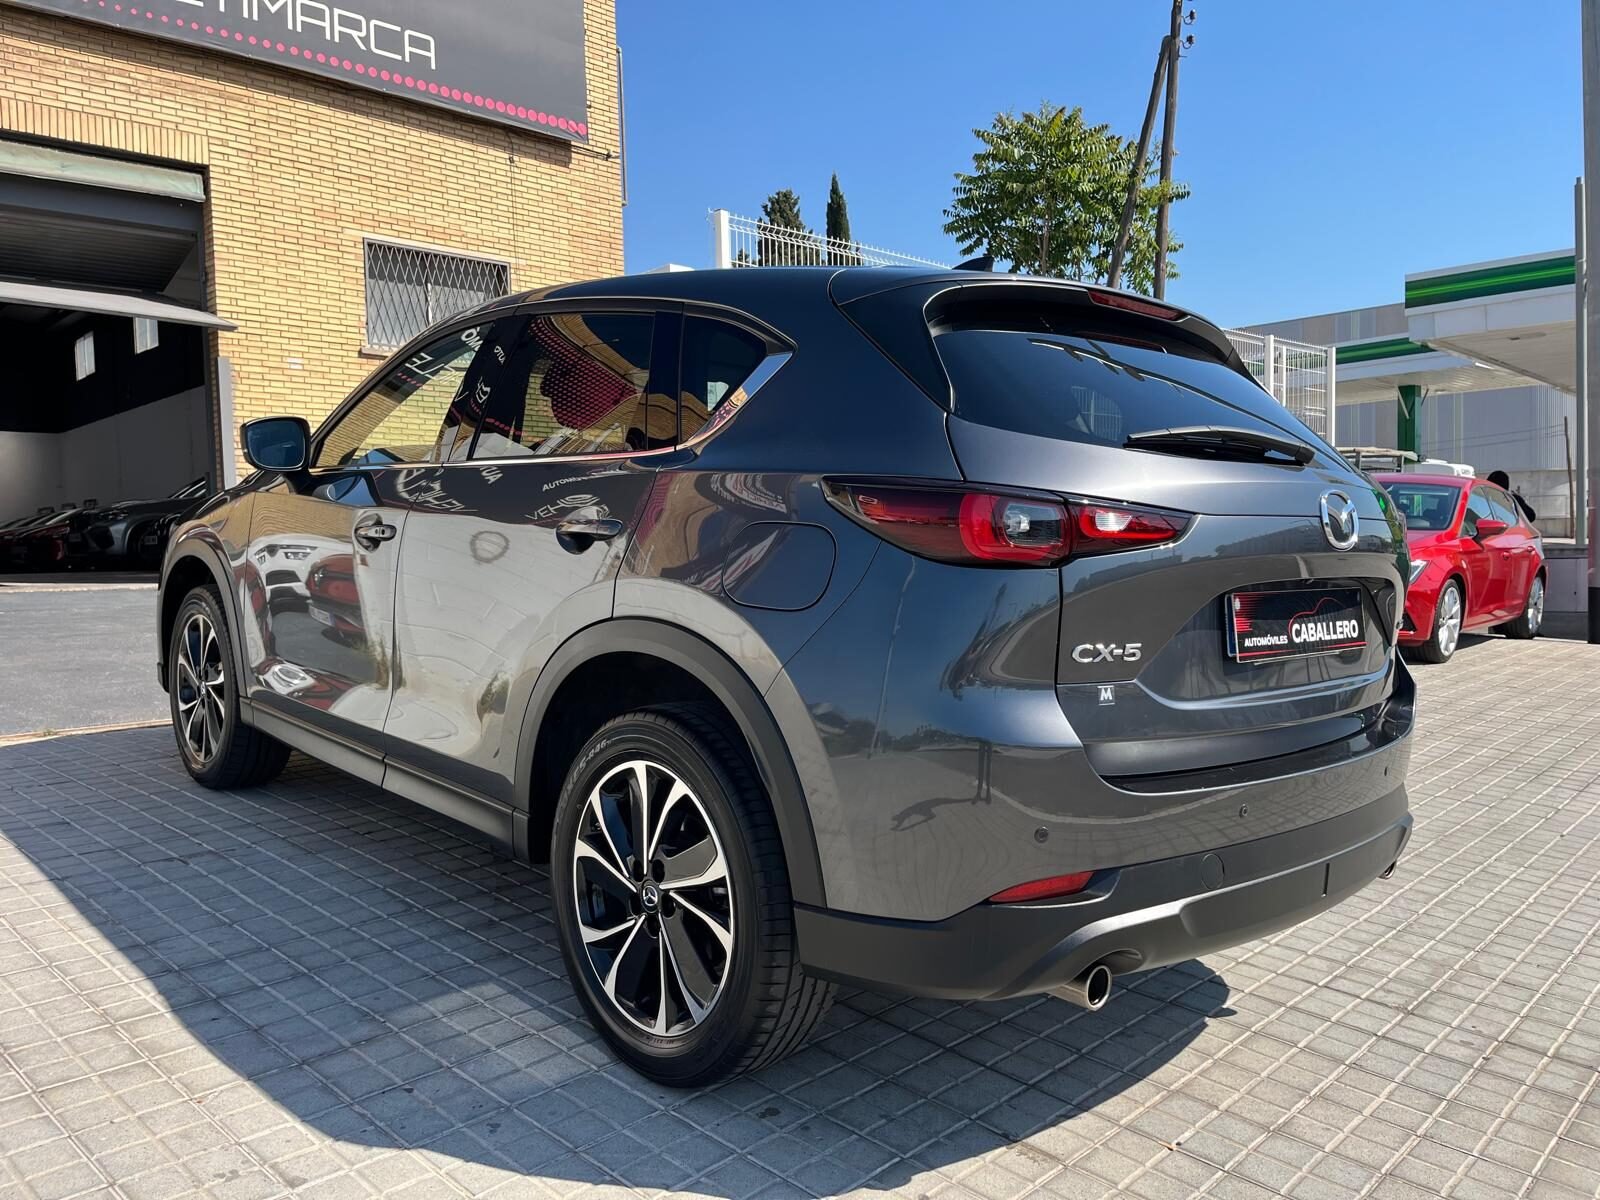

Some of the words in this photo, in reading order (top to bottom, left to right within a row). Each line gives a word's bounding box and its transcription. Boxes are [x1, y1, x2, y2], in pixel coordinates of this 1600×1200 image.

[175, 0, 436, 70] IMARCA
[1244, 634, 1289, 647] AUTOMÓVILES
[1292, 619, 1359, 644] CABALLERO
[1072, 643, 1142, 663] CX-5
